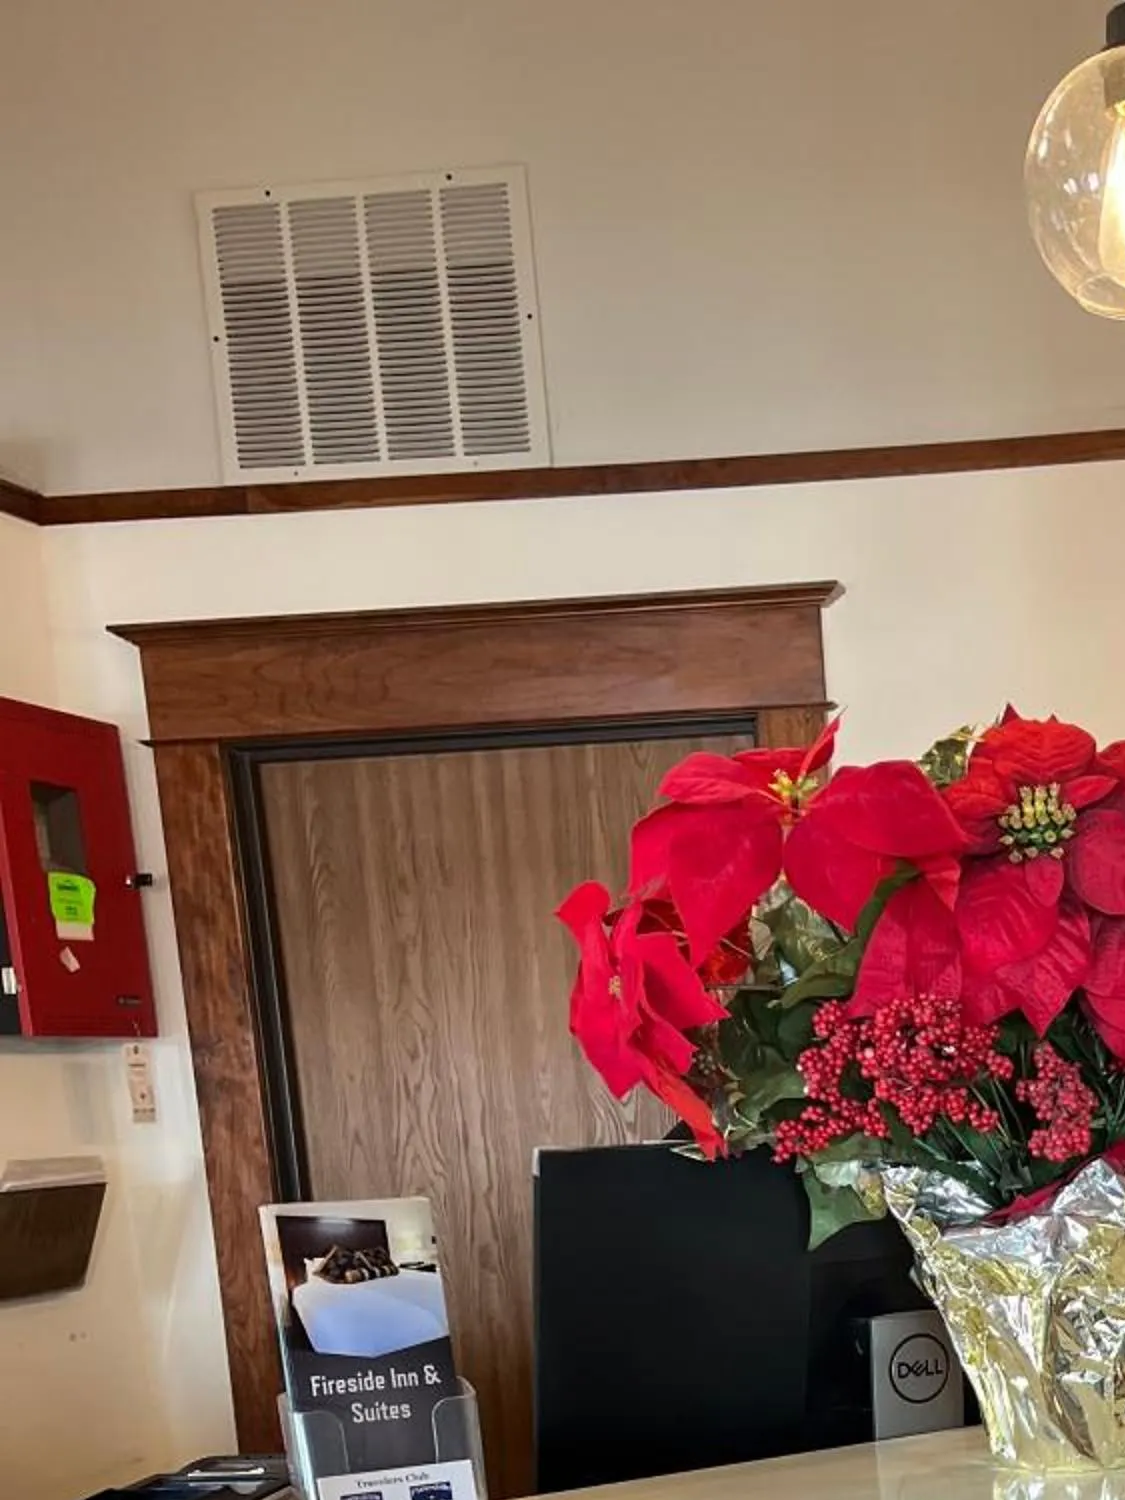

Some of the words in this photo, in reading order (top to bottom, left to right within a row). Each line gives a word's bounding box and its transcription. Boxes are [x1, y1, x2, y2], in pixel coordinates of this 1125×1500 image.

[897, 1359, 944, 1379] DELL
[310, 1369, 385, 1397] Fireside
[390, 1367, 419, 1388] Inn
[423, 1364, 441, 1385] &
[351, 1401, 412, 1423] Suites
